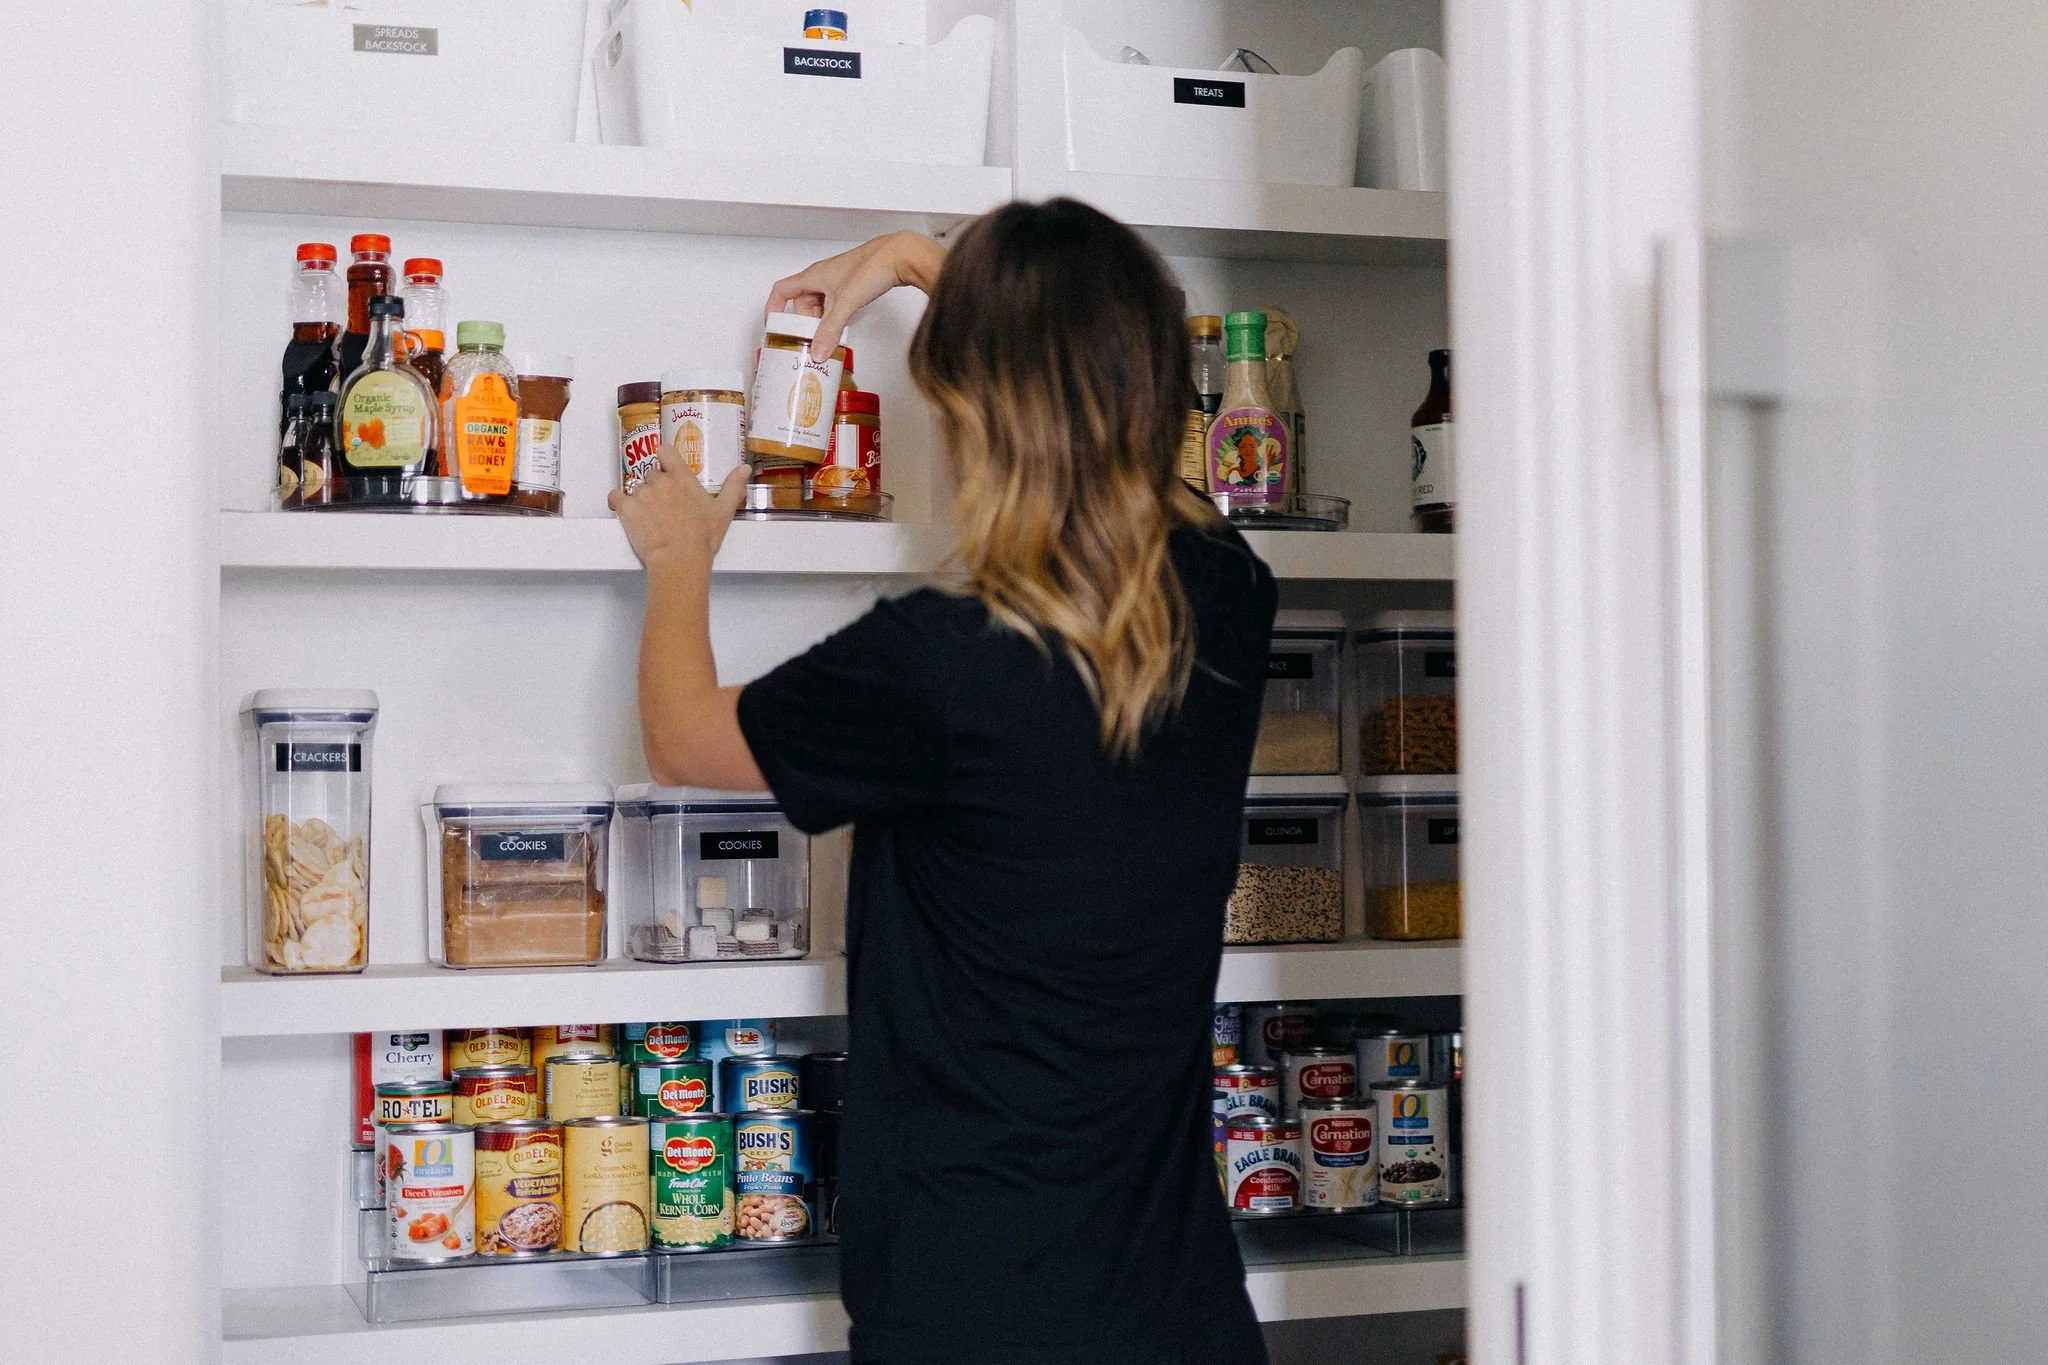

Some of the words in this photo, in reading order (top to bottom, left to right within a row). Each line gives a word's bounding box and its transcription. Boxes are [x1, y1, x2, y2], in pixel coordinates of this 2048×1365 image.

[375, 27, 419, 39] SPREADS
[365, 40, 428, 52] BACKSTOCK
[794, 56, 852, 69] BACKSTOCK
[1193, 87, 1224, 98] TREATS
[353, 393, 391, 404] Organic
[354, 403, 383, 415] Maple
[385, 403, 416, 415] Syrup
[1223, 415, 1274, 428] Annie's
[467, 424, 508, 435] ORGANIC
[498, 437, 506, 448] &
[469, 455, 506, 466] HONEY
[293, 752, 348, 762] CRACKERS
[499, 840, 547, 851] COOKIES
[718, 840, 762, 850] COOKIES
[649, 1035, 664, 1046] Del
[665, 1034, 688, 1045] Monte
[734, 1032, 759, 1043] Dole
[469, 1042, 486, 1053] OLD
[386, 1051, 434, 1066] Cherry
[748, 1076, 798, 1098] BUSH'S
[662, 1089, 679, 1101] Del
[680, 1088, 704, 1100] Monte
[475, 1097, 493, 1109] OLD
[1312, 1123, 1371, 1144] Carnation
[740, 1132, 790, 1151] BUSH'S
[667, 1146, 681, 1158] Del
[682, 1146, 713, 1158] Monte
[1234, 1148, 1270, 1173] EAGLE
[415, 1165, 453, 1176] organics
[737, 1172, 758, 1184] Pinto
[760, 1172, 795, 1184] Beans
[1249, 1176, 1293, 1184] Condensed
[404, 1188, 427, 1198] Diced
[428, 1186, 463, 1197] Tomatoes
[1262, 1183, 1282, 1192] Milk
[672, 1192, 706, 1205] WHOLE
[660, 1202, 693, 1216] KERNEL
[694, 1203, 720, 1216] CORN
